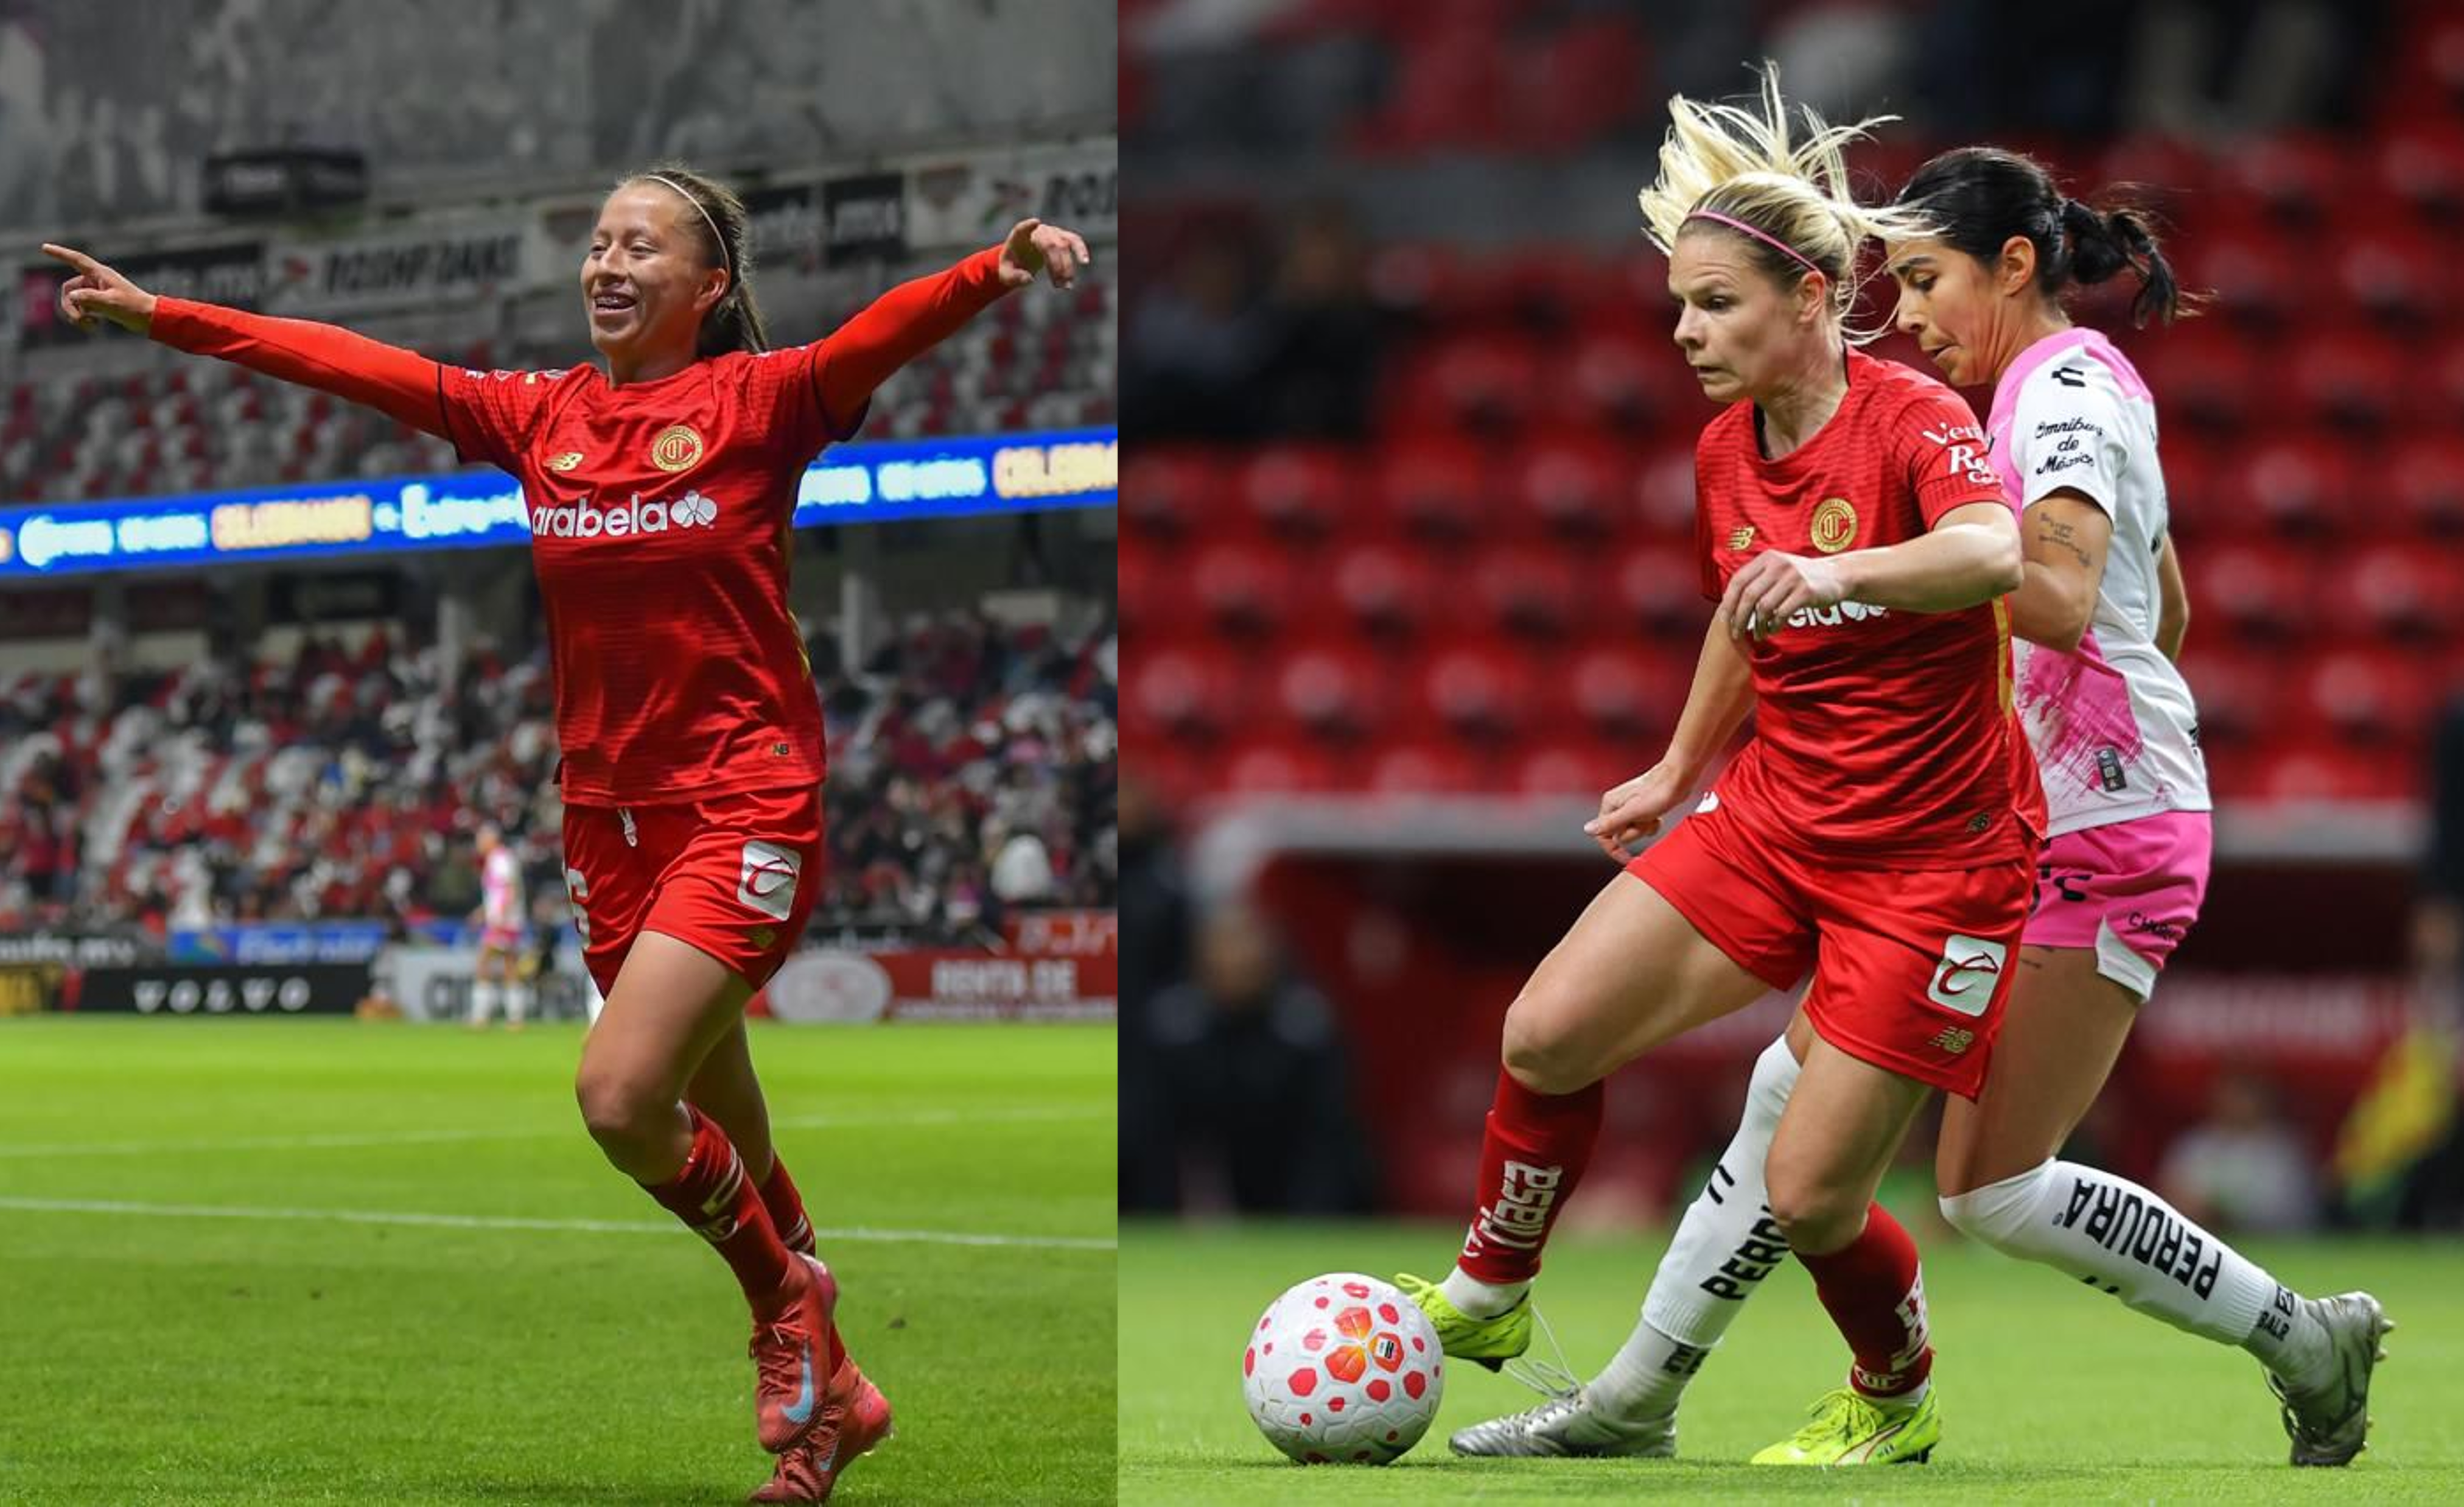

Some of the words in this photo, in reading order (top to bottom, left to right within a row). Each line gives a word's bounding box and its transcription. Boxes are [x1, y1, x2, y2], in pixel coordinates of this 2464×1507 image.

[2057, 434, 2080, 452] de
[533, 493, 668, 537] arabela
[133, 977, 310, 1013] VOLVO
[1699, 1204, 1791, 1301] PERD
[2062, 1178, 2222, 1301] PERDURA
